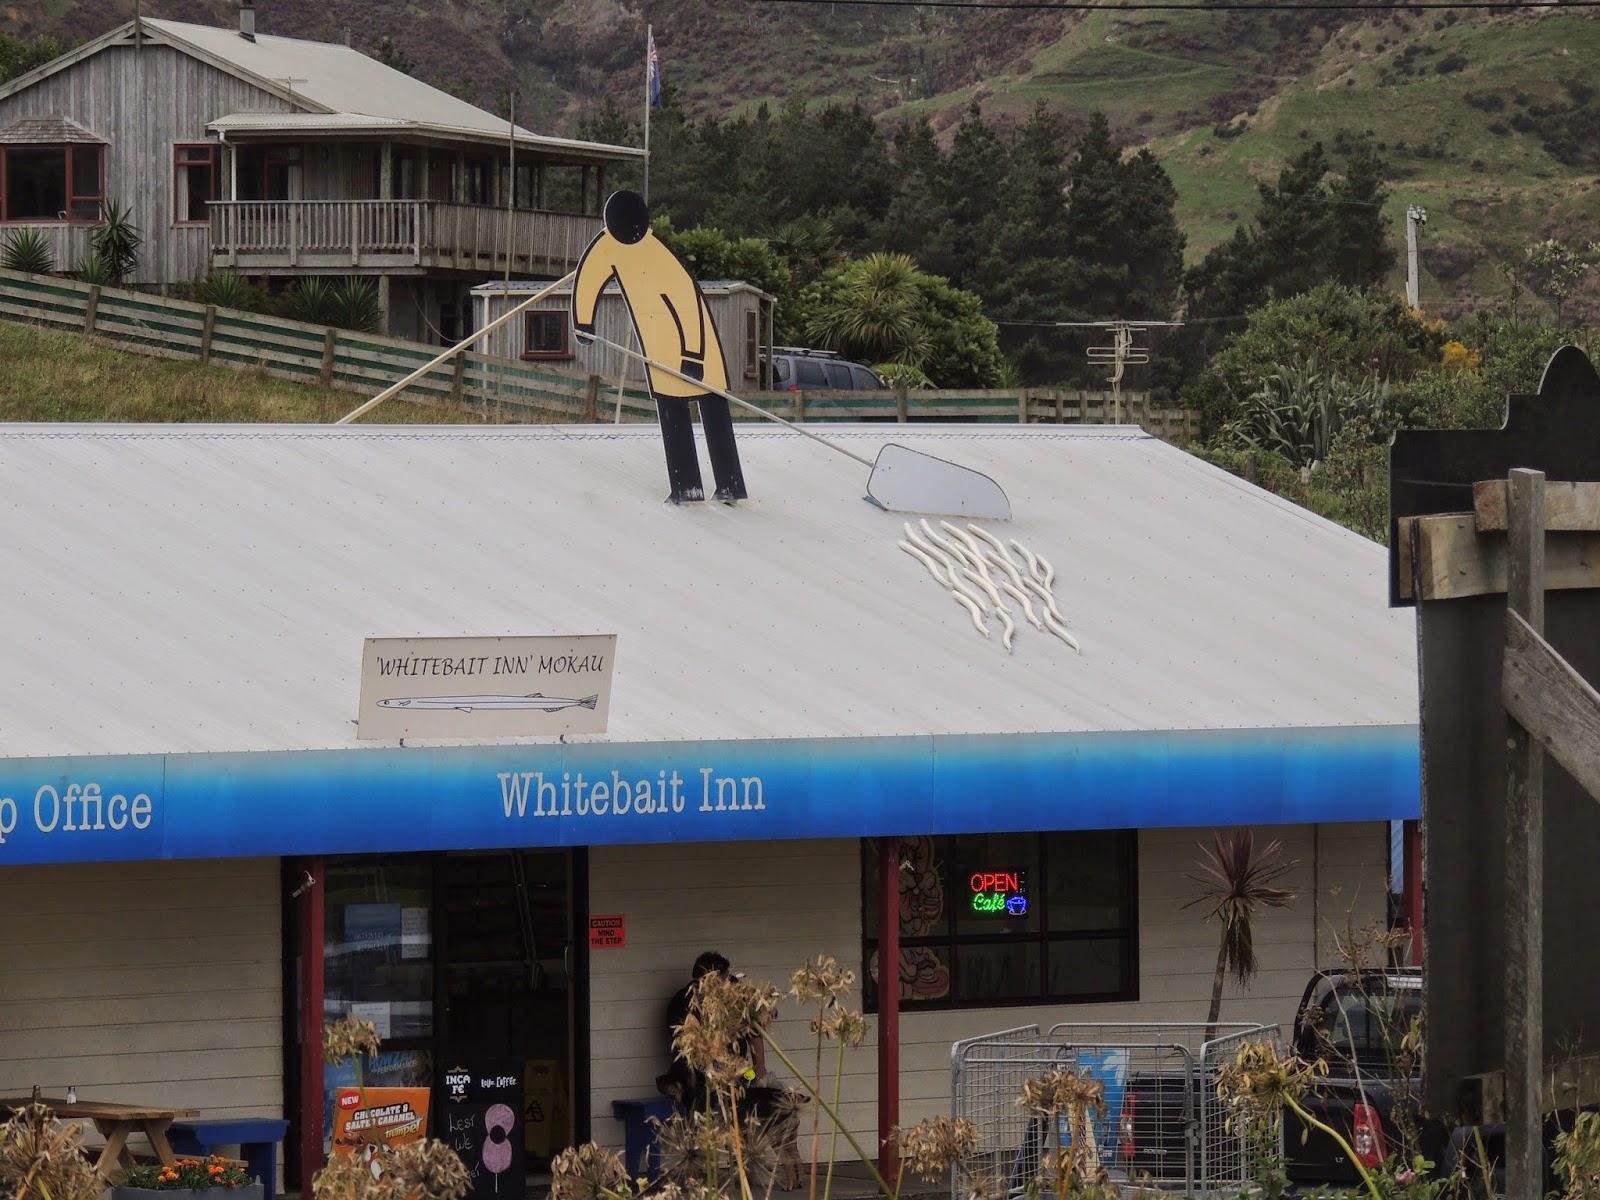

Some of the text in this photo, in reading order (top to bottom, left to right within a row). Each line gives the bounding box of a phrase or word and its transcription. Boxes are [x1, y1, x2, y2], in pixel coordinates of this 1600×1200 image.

[376, 654, 604, 676] 'WHITEBAIT INN' MOKAU
[496, 767, 766, 818] Whitebait Inn
[33, 783, 152, 832] Office
[970, 872, 1018, 892] OPEN
[973, 893, 1006, 912] Café
[592, 920, 621, 928] CAUTION
[446, 1075, 471, 1085] INCA
[341, 1095, 359, 1106] NEW
[378, 1112, 416, 1125] CARAMEL
